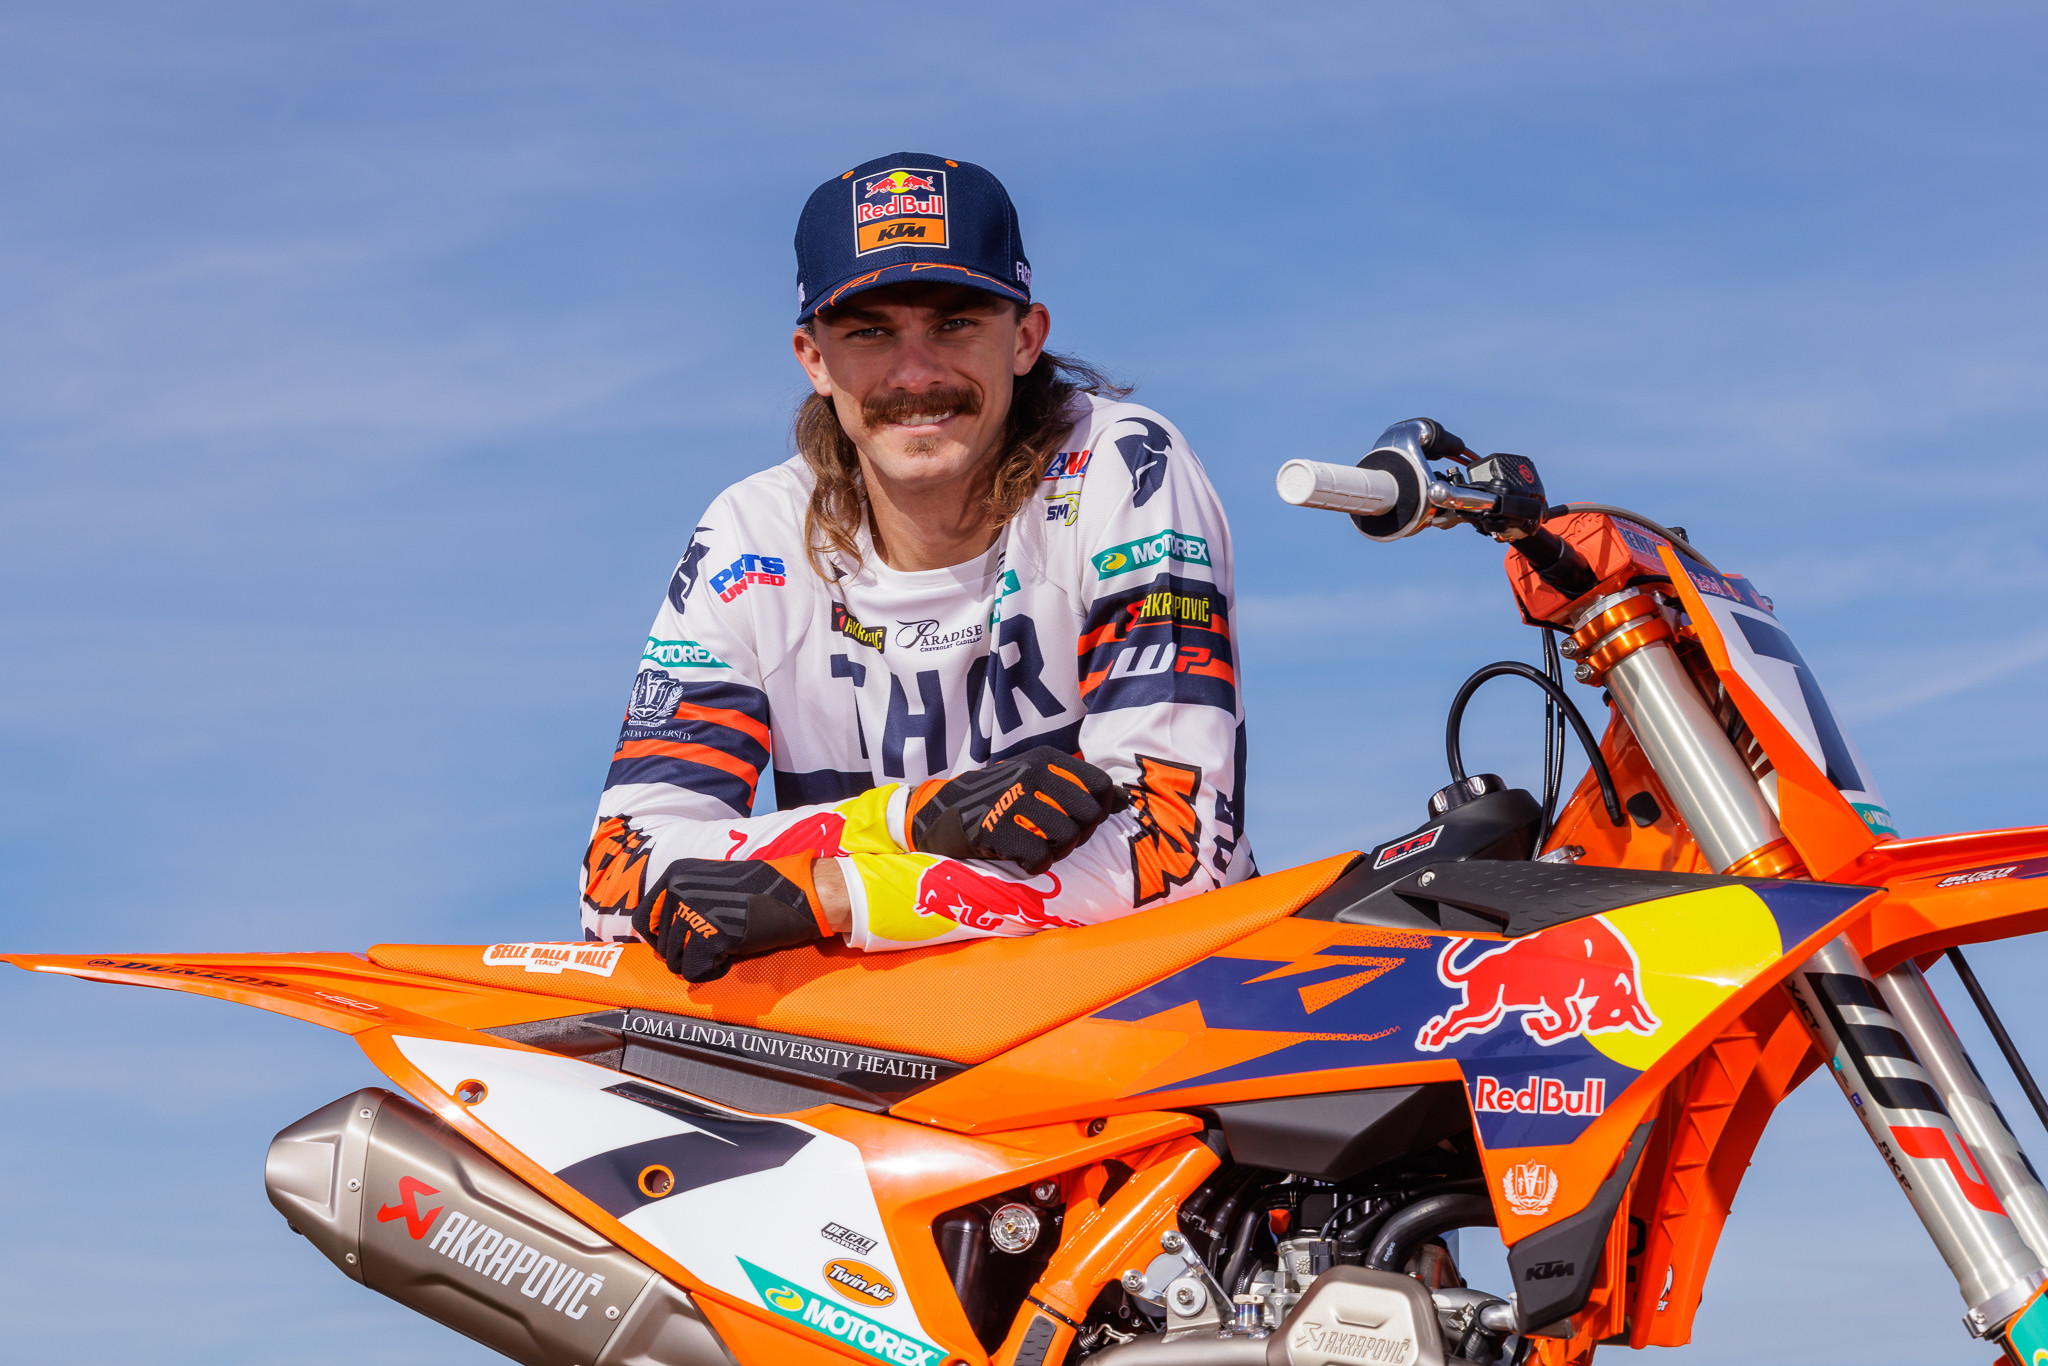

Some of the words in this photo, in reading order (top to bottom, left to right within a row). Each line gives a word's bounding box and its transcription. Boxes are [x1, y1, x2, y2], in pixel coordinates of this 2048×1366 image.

[858, 194, 899, 223] Red
[901, 194, 944, 215] Bull
[877, 223, 926, 242] KTM
[1132, 534, 1209, 567] MOTOREX
[719, 572, 786, 604] UNTED
[896, 619, 983, 649] PARADISE
[1109, 642, 1211, 680] WP
[981, 782, 1026, 833] THOR
[1382, 831, 1436, 861] ETS
[677, 900, 719, 940] THOR
[490, 944, 530, 960] SELLE
[530, 948, 571, 962] DALLA
[574, 950, 615, 969] VALLE
[534, 959, 560, 967] ITALY
[114, 961, 290, 988] DUNLOP
[1787, 980, 1821, 1031] XACT
[620, 1014, 675, 1039] LOMA
[679, 1023, 737, 1049] LINDA
[741, 1033, 854, 1069] UNIVERSITY
[855, 1054, 937, 1081] HEALTH
[1475, 1076, 1540, 1114] Red
[1540, 1077, 1606, 1117] Bull
[1878, 1140, 1913, 1191] SKF
[821, 1231, 868, 1256] WORKS
[825, 1223, 877, 1250] DECAL
[1383, 1241, 1396, 1262] engine
[429, 1211, 606, 1321] AKRAPOVIČ
[1524, 1260, 1575, 1282] KTM
[828, 1263, 869, 1292] Twin
[864, 1282, 895, 1302] Air
[802, 1297, 936, 1366] MOTOREX
[1323, 1331, 1412, 1364] AKRAPOVIČ
